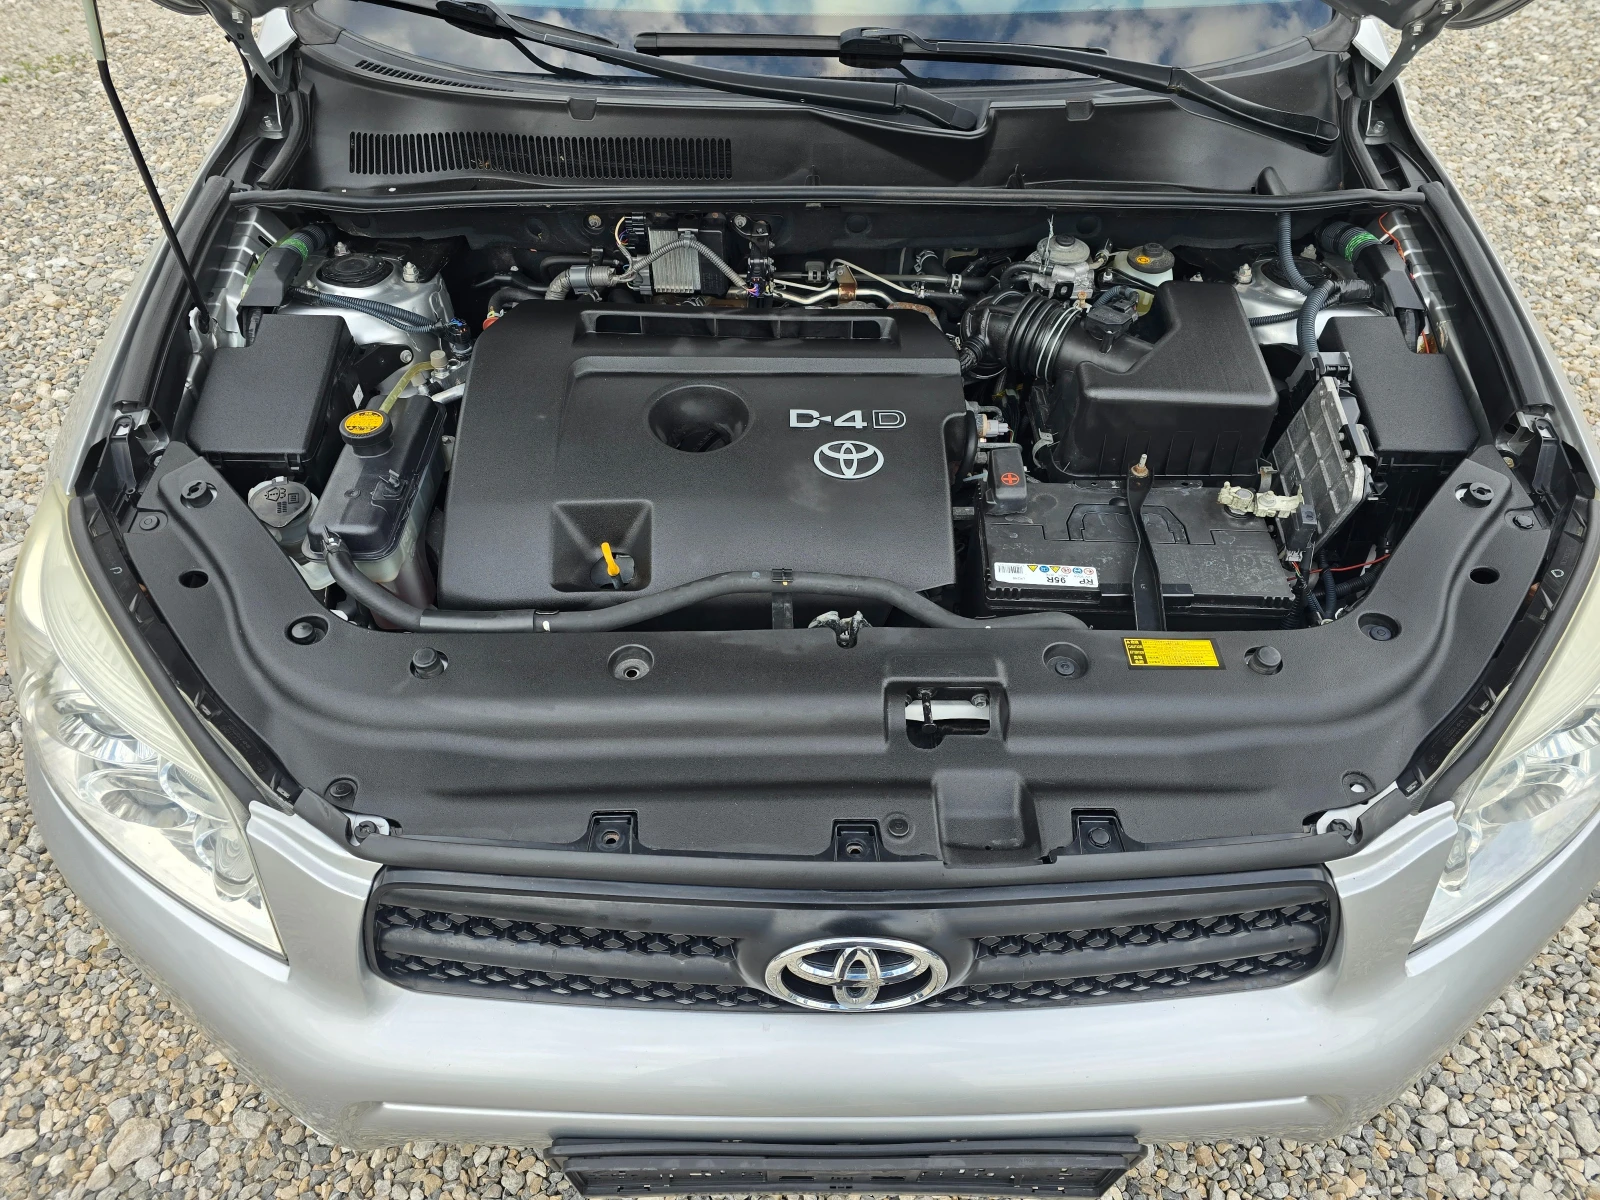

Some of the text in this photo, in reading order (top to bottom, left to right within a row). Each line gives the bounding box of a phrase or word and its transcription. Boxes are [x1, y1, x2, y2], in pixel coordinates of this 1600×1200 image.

[789, 408, 907, 429] D-4D
[1046, 576, 1066, 584] 95R
[1079, 578, 1094, 586] RP
